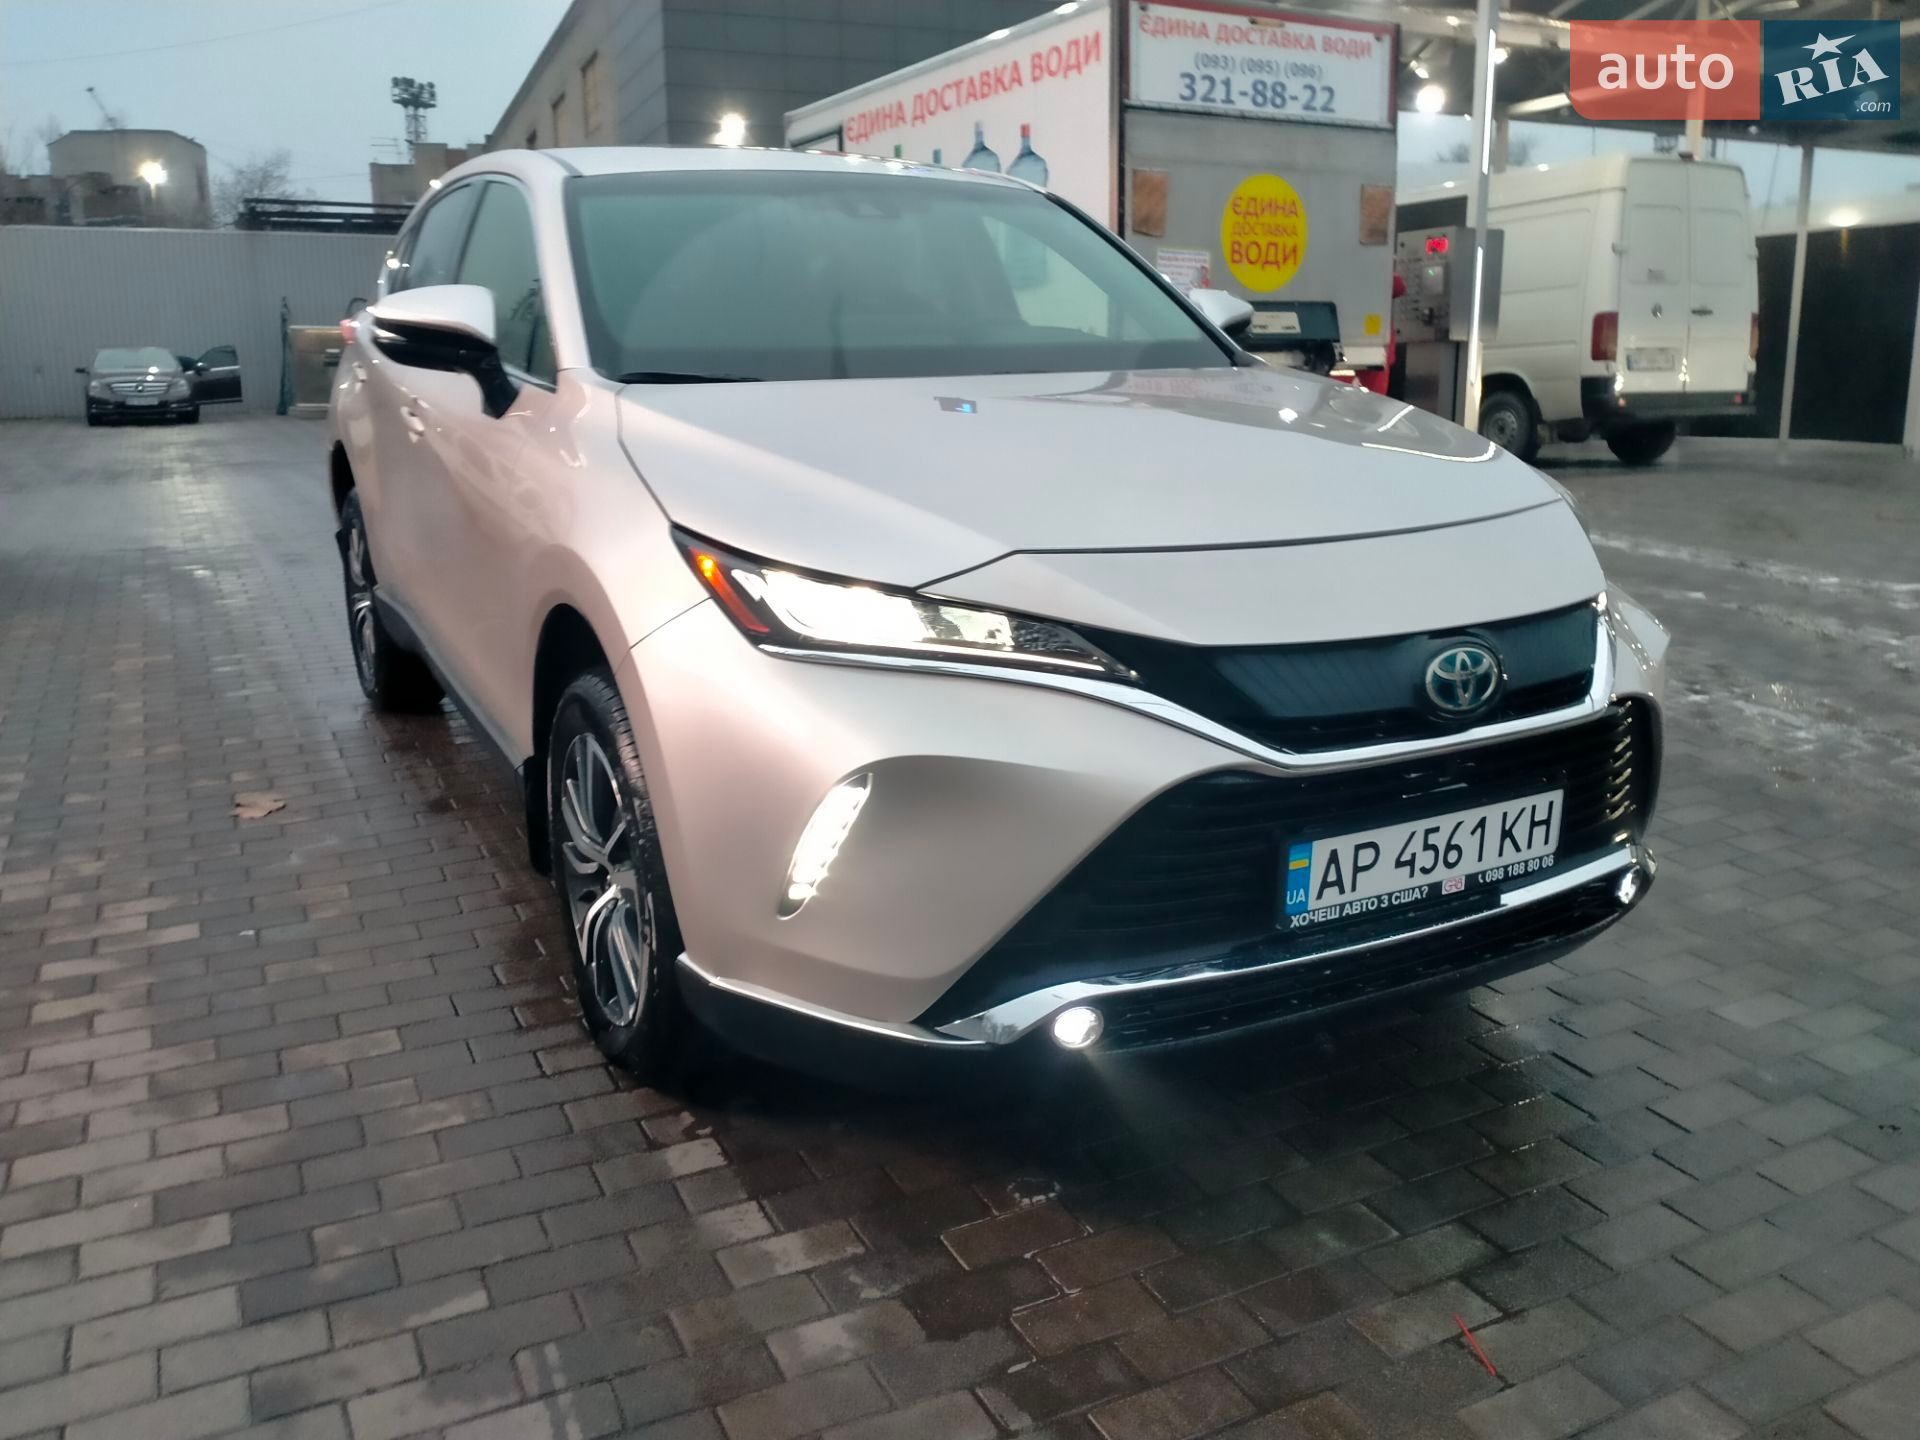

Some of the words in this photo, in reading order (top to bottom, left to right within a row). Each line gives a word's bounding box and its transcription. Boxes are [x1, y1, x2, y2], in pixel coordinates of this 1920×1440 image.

[1138, 15, 1210, 40] ЄДИНА
[1215, 22, 1316, 53] ДОСТАВКА
[1321, 37, 1373, 60] ВОДИ
[845, 99, 908, 144] ЄДИНА
[911, 59, 1023, 127] ДОСТАВКА
[1030, 31, 1102, 83] ВОДИ
[1179, 72, 1336, 113] 321-88-22
[1230, 196, 1299, 220] ЄДИНА
[1230, 240, 1298, 272] ВОДИ
[1315, 840, 1381, 901] AP
[1393, 816, 1488, 880] 4561
[1286, 888, 1306, 905] UA
[1289, 905, 1340, 928] ХОЧЕШ
[1342, 898, 1378, 917] АВТО
[1391, 886, 1429, 905] США?
[1485, 867, 1505, 883] 098
[1507, 862, 1526, 878] 188
[1527, 858, 1540, 873] 80
